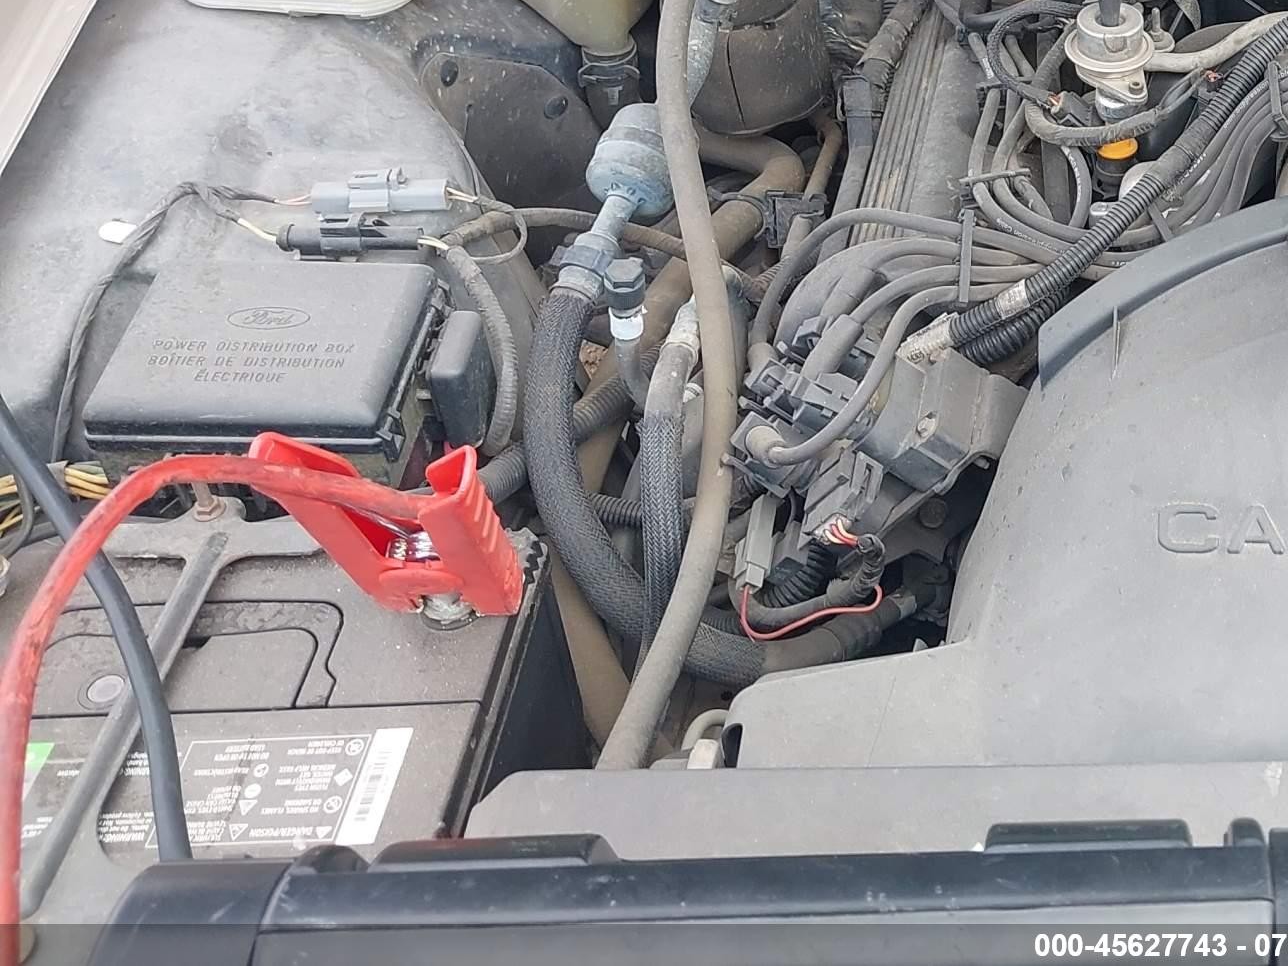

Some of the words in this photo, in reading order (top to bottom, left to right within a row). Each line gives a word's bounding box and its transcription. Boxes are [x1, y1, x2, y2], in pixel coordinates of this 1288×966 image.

[152, 339, 207, 353] POWER
[215, 340, 317, 353] DISTRIBUTION
[324, 342, 355, 354] BOX
[215, 356, 236, 368] DE
[244, 357, 345, 369] DISTRIBUTION
